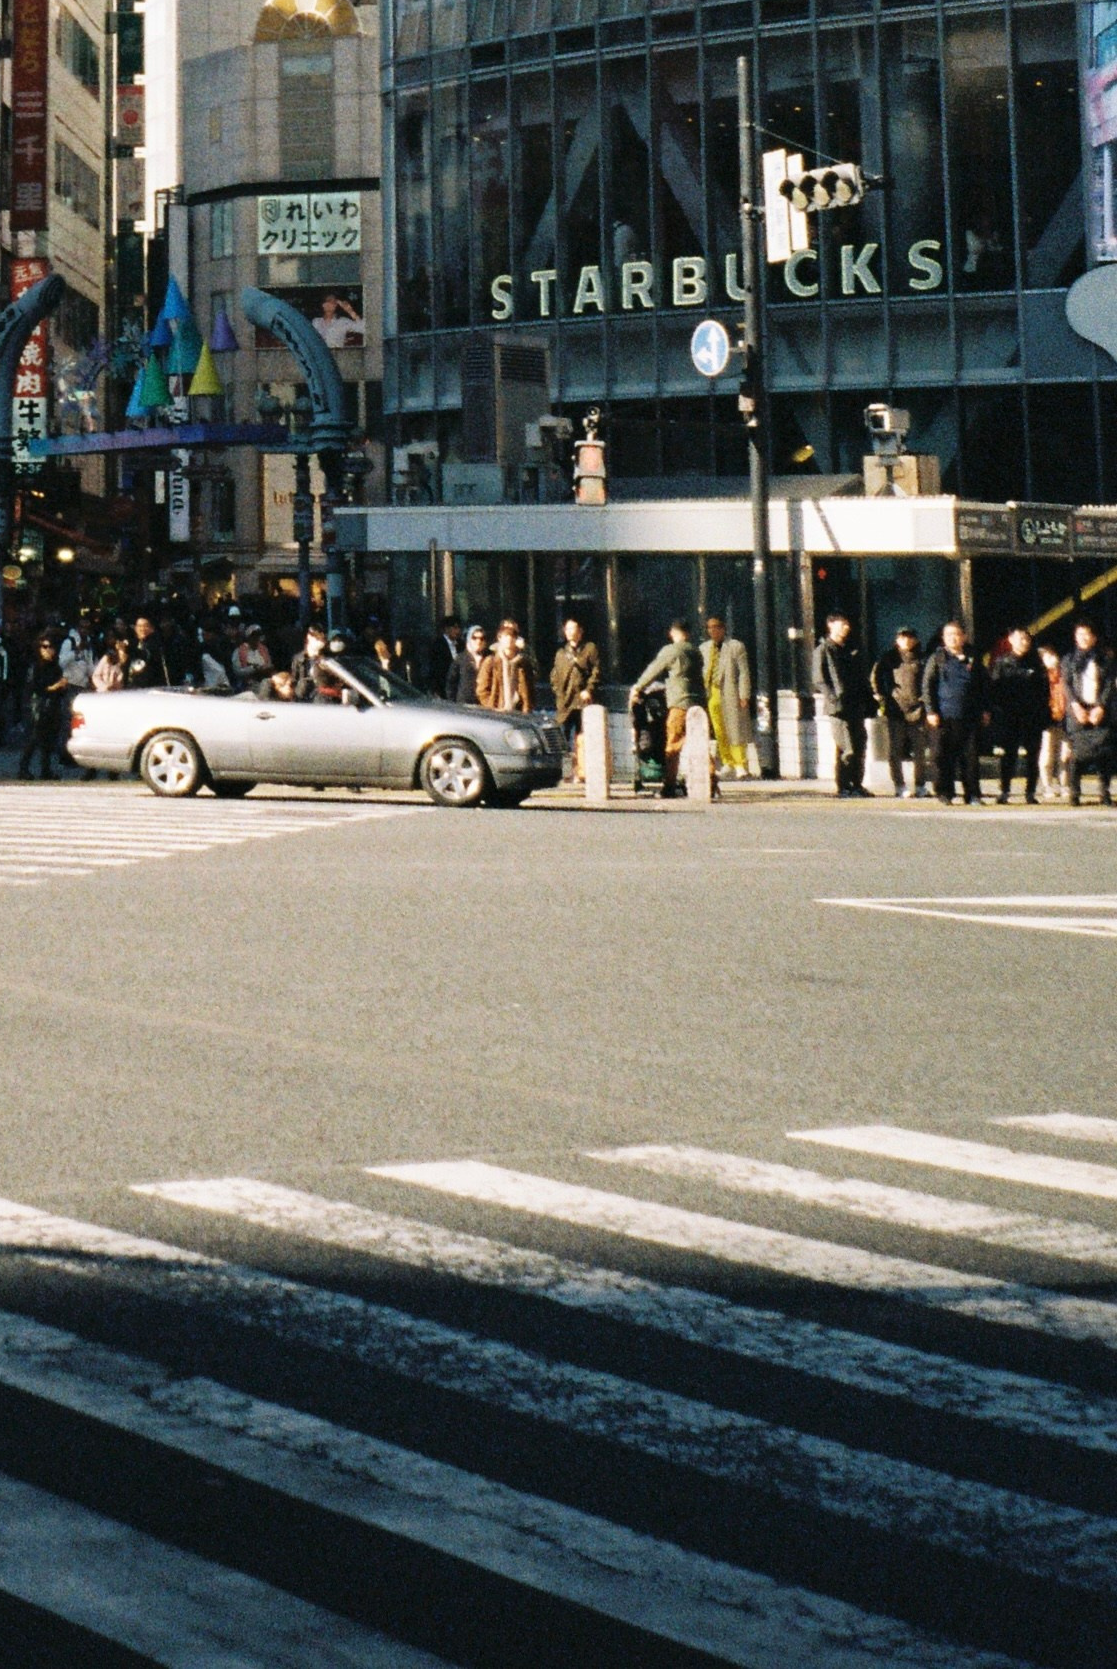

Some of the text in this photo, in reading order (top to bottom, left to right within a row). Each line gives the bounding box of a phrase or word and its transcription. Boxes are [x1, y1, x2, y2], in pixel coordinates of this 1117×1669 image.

[286, 198, 359, 222] れいわ
[262, 228, 359, 250] クリニック
[490, 239, 944, 321] STARBUCKS
